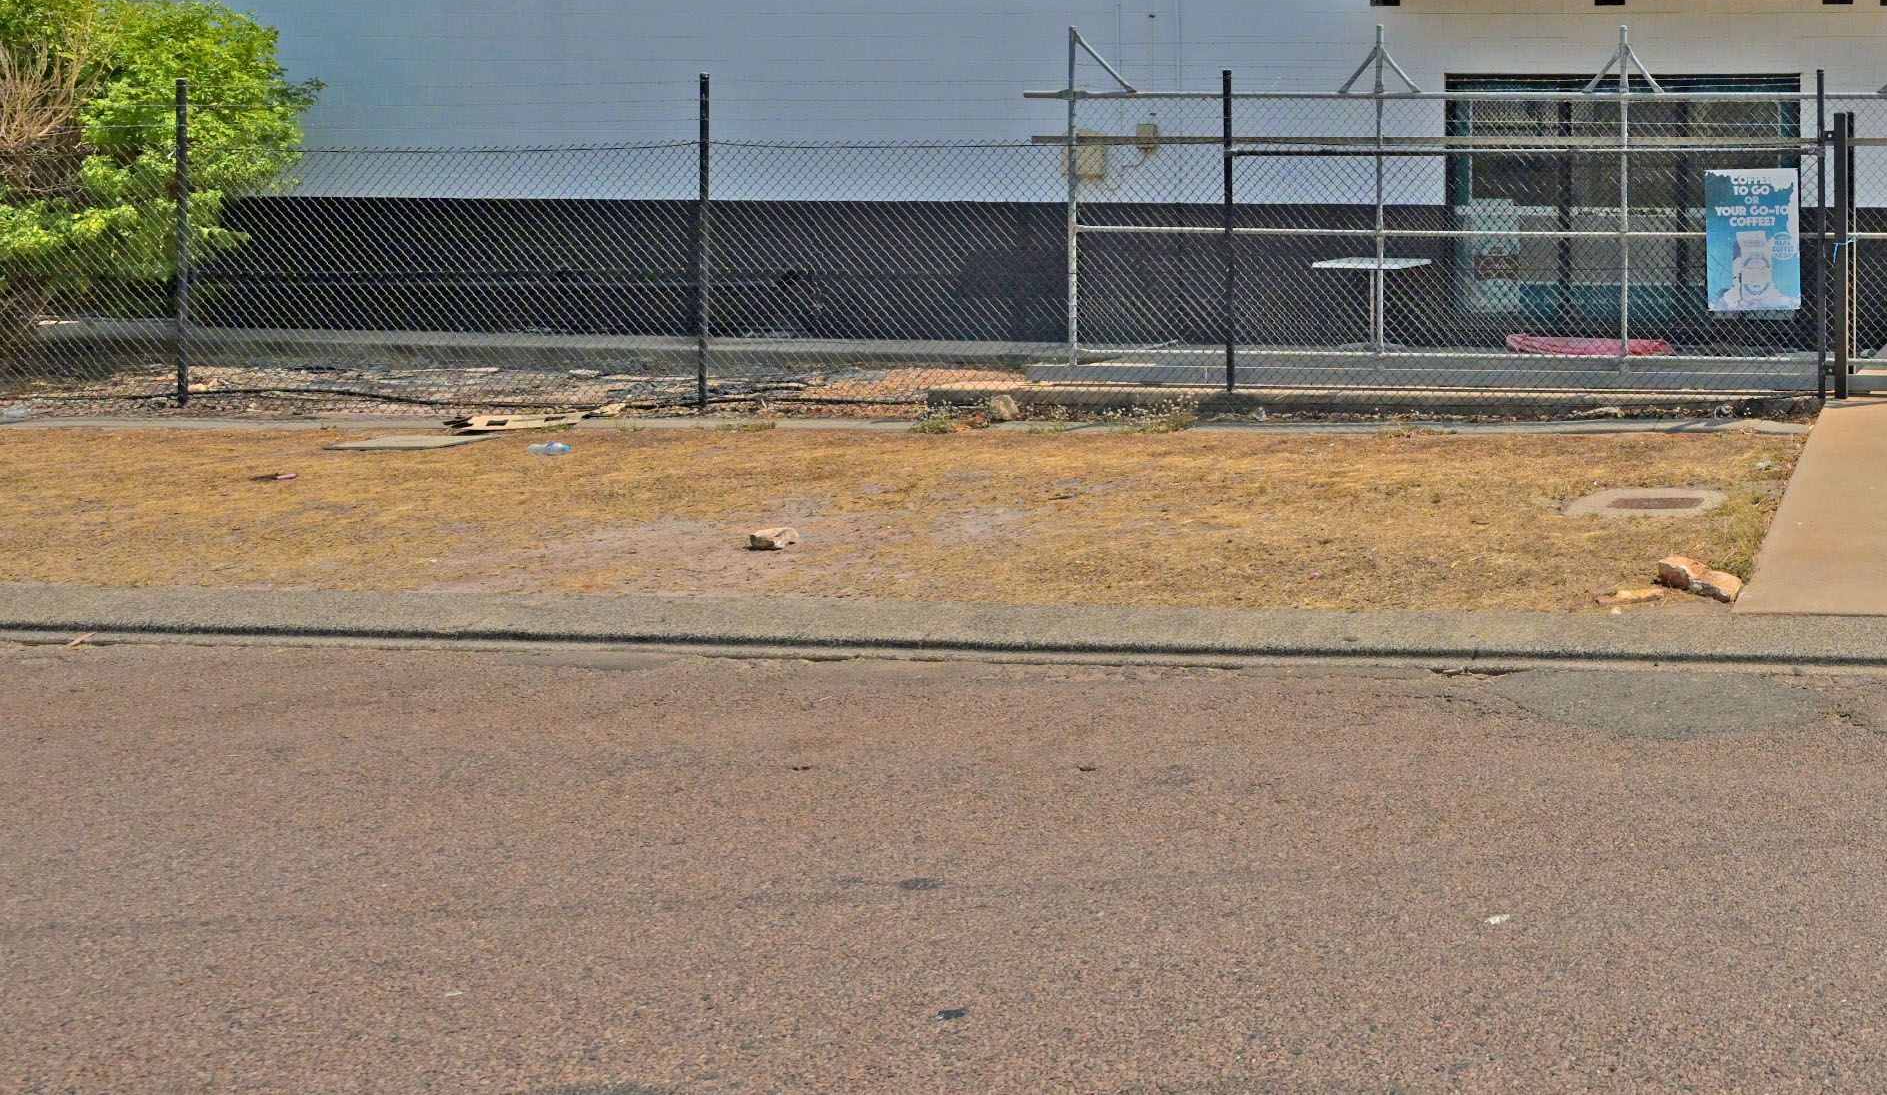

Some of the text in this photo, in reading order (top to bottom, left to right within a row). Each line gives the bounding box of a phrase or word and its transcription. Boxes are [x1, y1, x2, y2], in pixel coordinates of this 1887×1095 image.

[1730, 176, 1772, 185] COFFEE
[1733, 185, 1770, 195] TO GO
[1744, 196, 1760, 205] OR
[1715, 205, 1789, 216] YOUR GO-TO
[1729, 217, 1776, 227] COFFEE?
